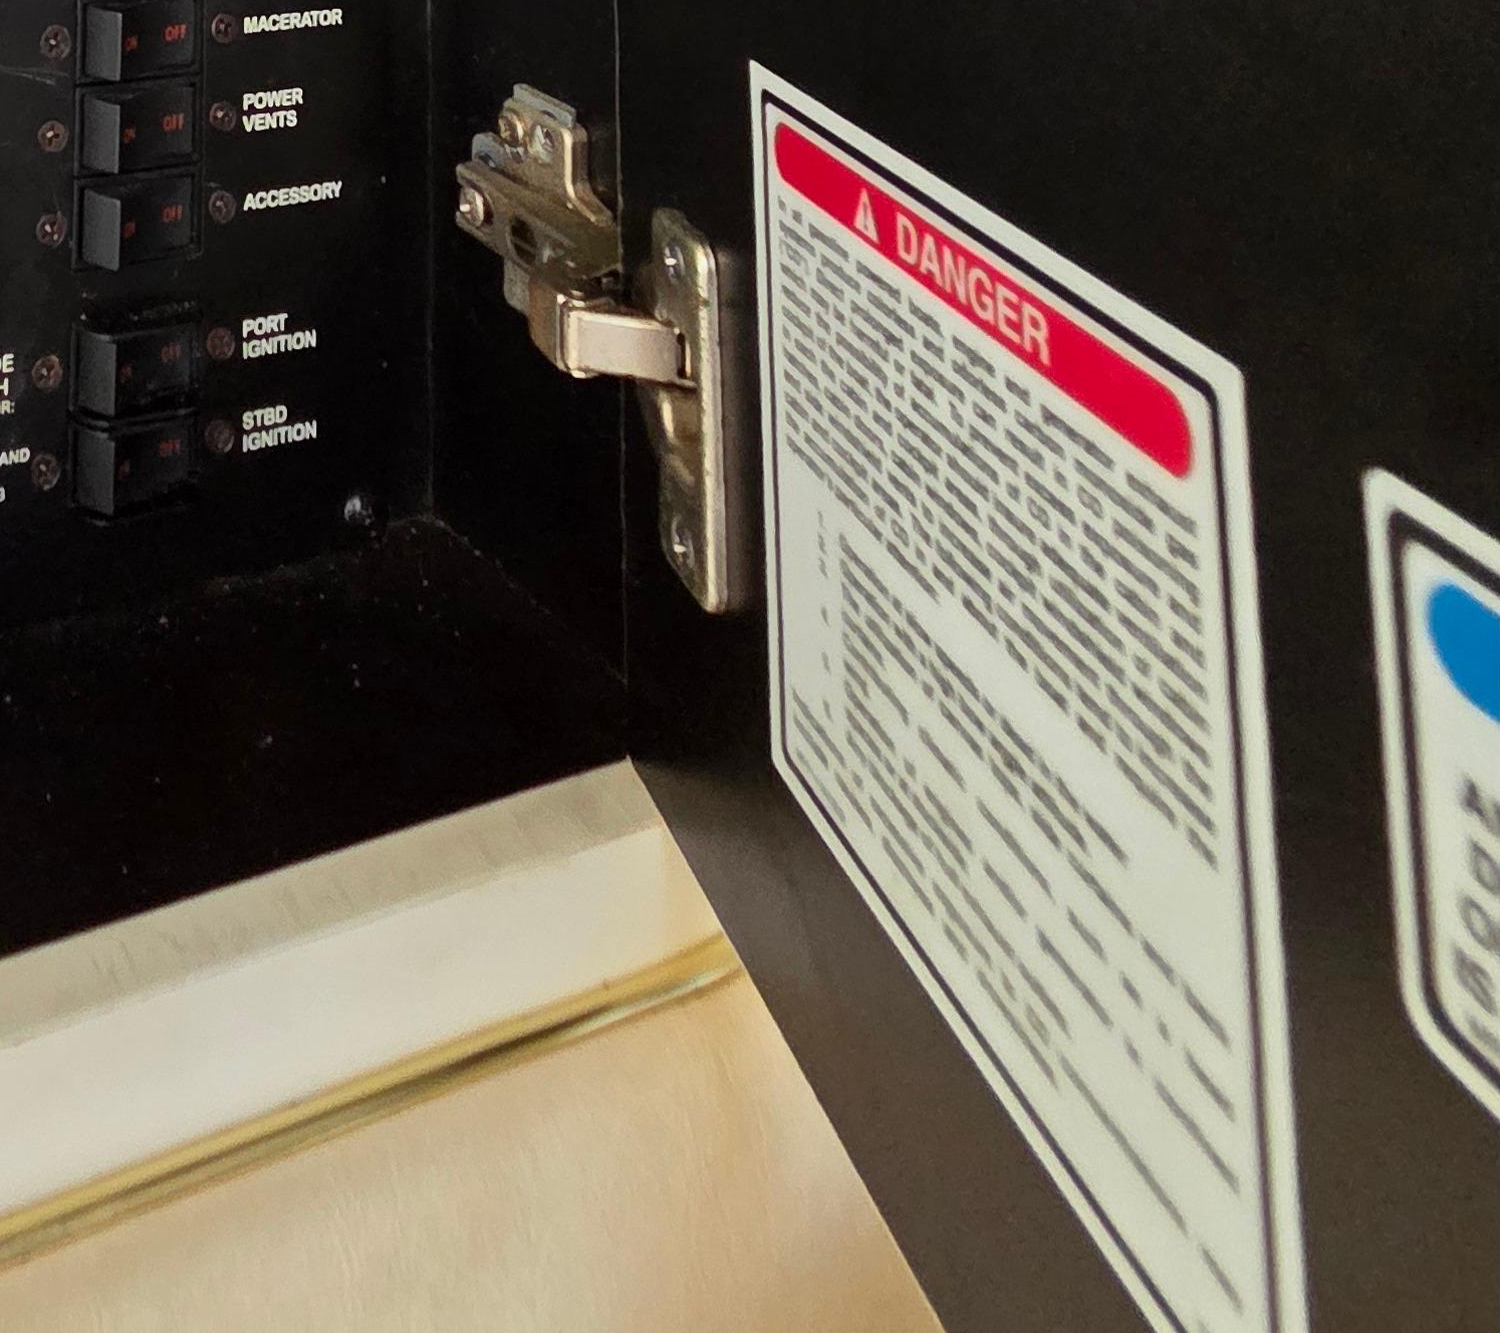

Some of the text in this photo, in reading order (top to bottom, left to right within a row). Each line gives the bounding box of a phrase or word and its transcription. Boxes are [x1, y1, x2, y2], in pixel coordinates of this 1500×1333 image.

[244, 9, 342, 34] MACERATOR
[243, 88, 303, 110] POWER
[242, 111, 297, 132] VENTS
[243, 181, 342, 211] ACCESSORY
[895, 212, 1051, 366] DANGER
[243, 313, 288, 338] PORT
[243, 330, 316, 359] IGNITION
[243, 406, 287, 430] STBD
[243, 421, 316, 452] IGNITION
